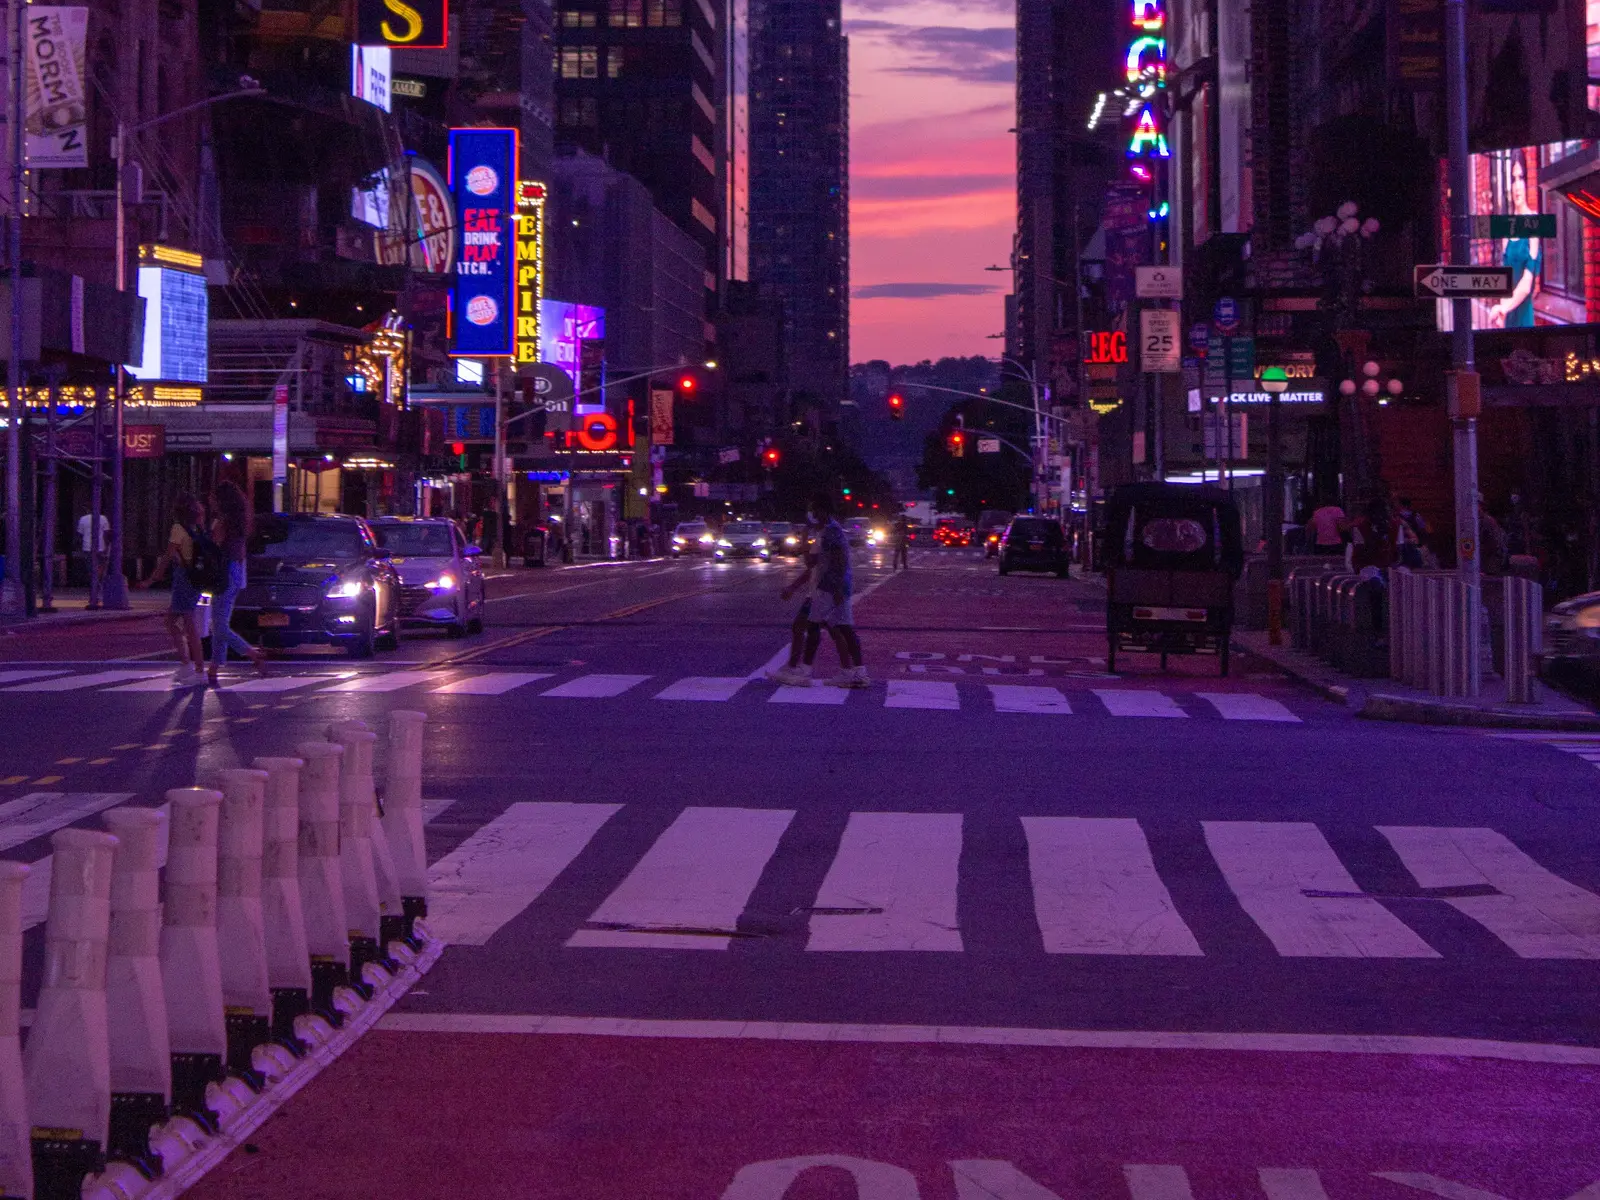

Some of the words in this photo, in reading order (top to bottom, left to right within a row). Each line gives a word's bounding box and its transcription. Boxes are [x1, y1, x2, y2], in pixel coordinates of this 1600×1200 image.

[517, 215, 537, 363] EMPIRE
[1430, 275, 1459, 289] ONE
[1471, 275, 1500, 286] WAY
[1146, 336, 1173, 351] 25
[1253, 364, 1316, 379] VORY
[1279, 392, 1323, 402] MATTER
